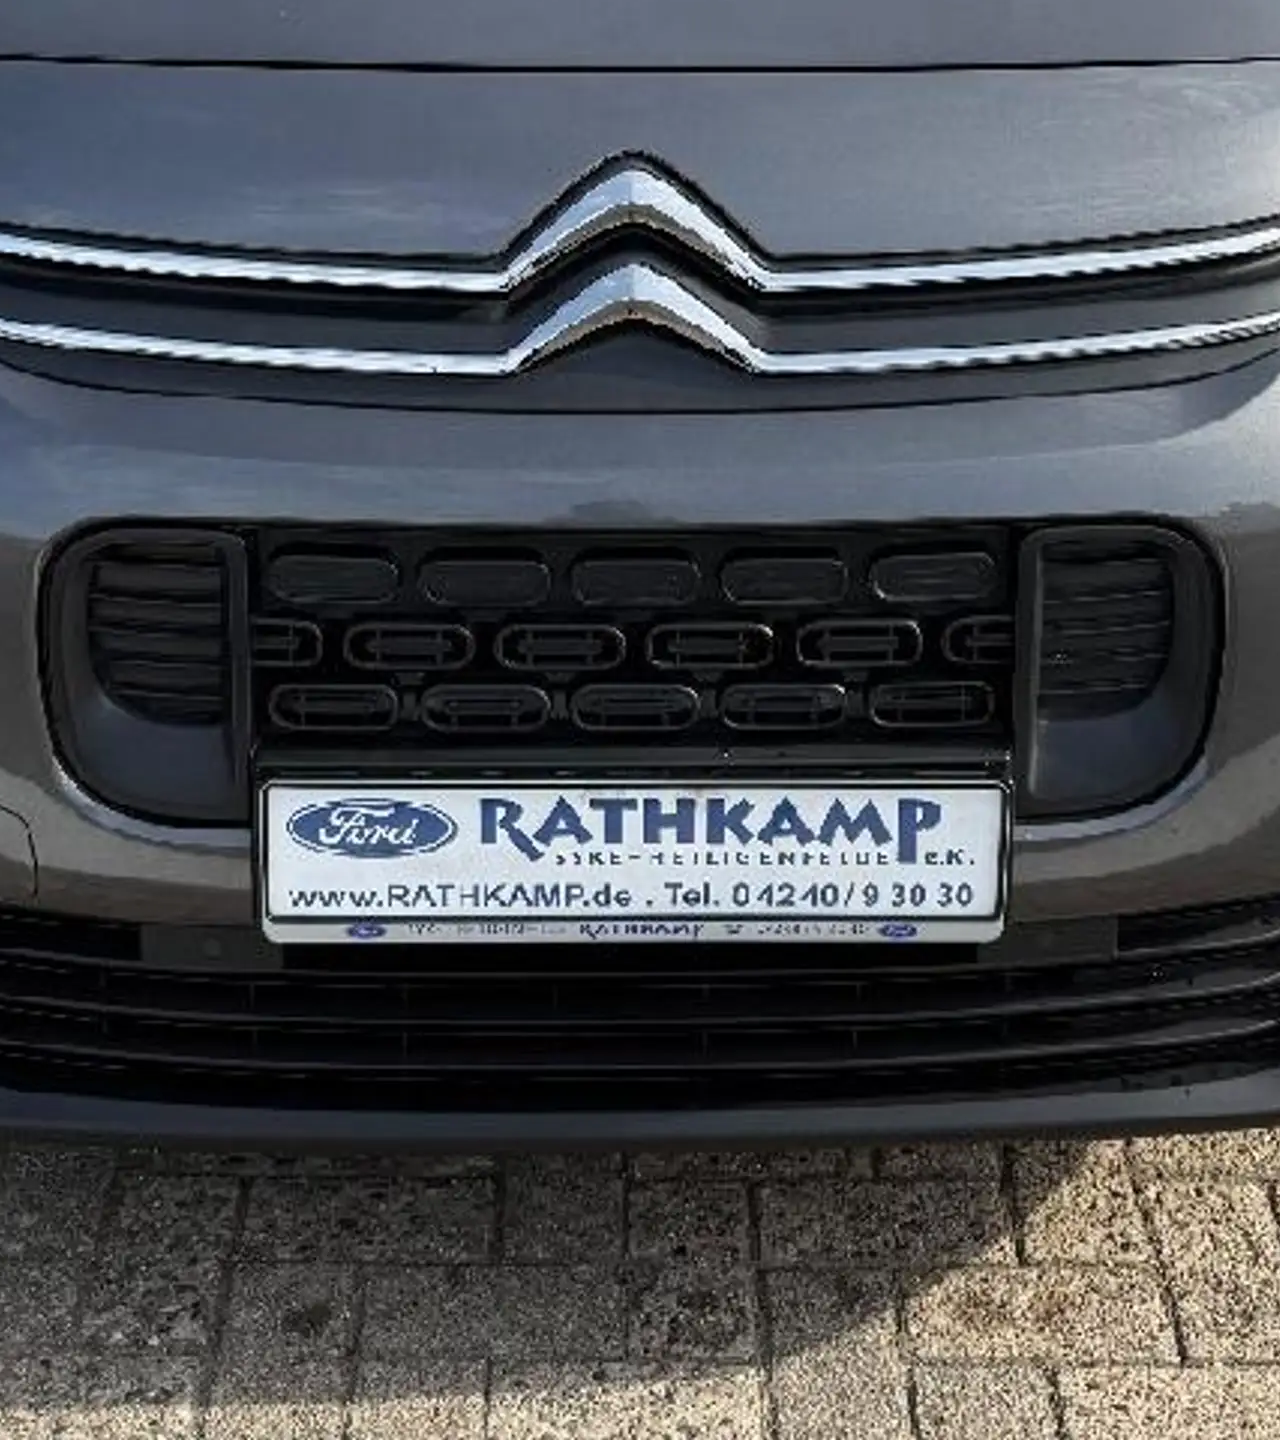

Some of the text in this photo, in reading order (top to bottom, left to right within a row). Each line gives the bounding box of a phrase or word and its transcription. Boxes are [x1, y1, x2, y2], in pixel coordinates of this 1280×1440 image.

[318, 794, 942, 864] Ford RATHKAMP
[288, 882, 632, 908] www.RATHKAMP.de
[664, 881, 721, 908] Tel.
